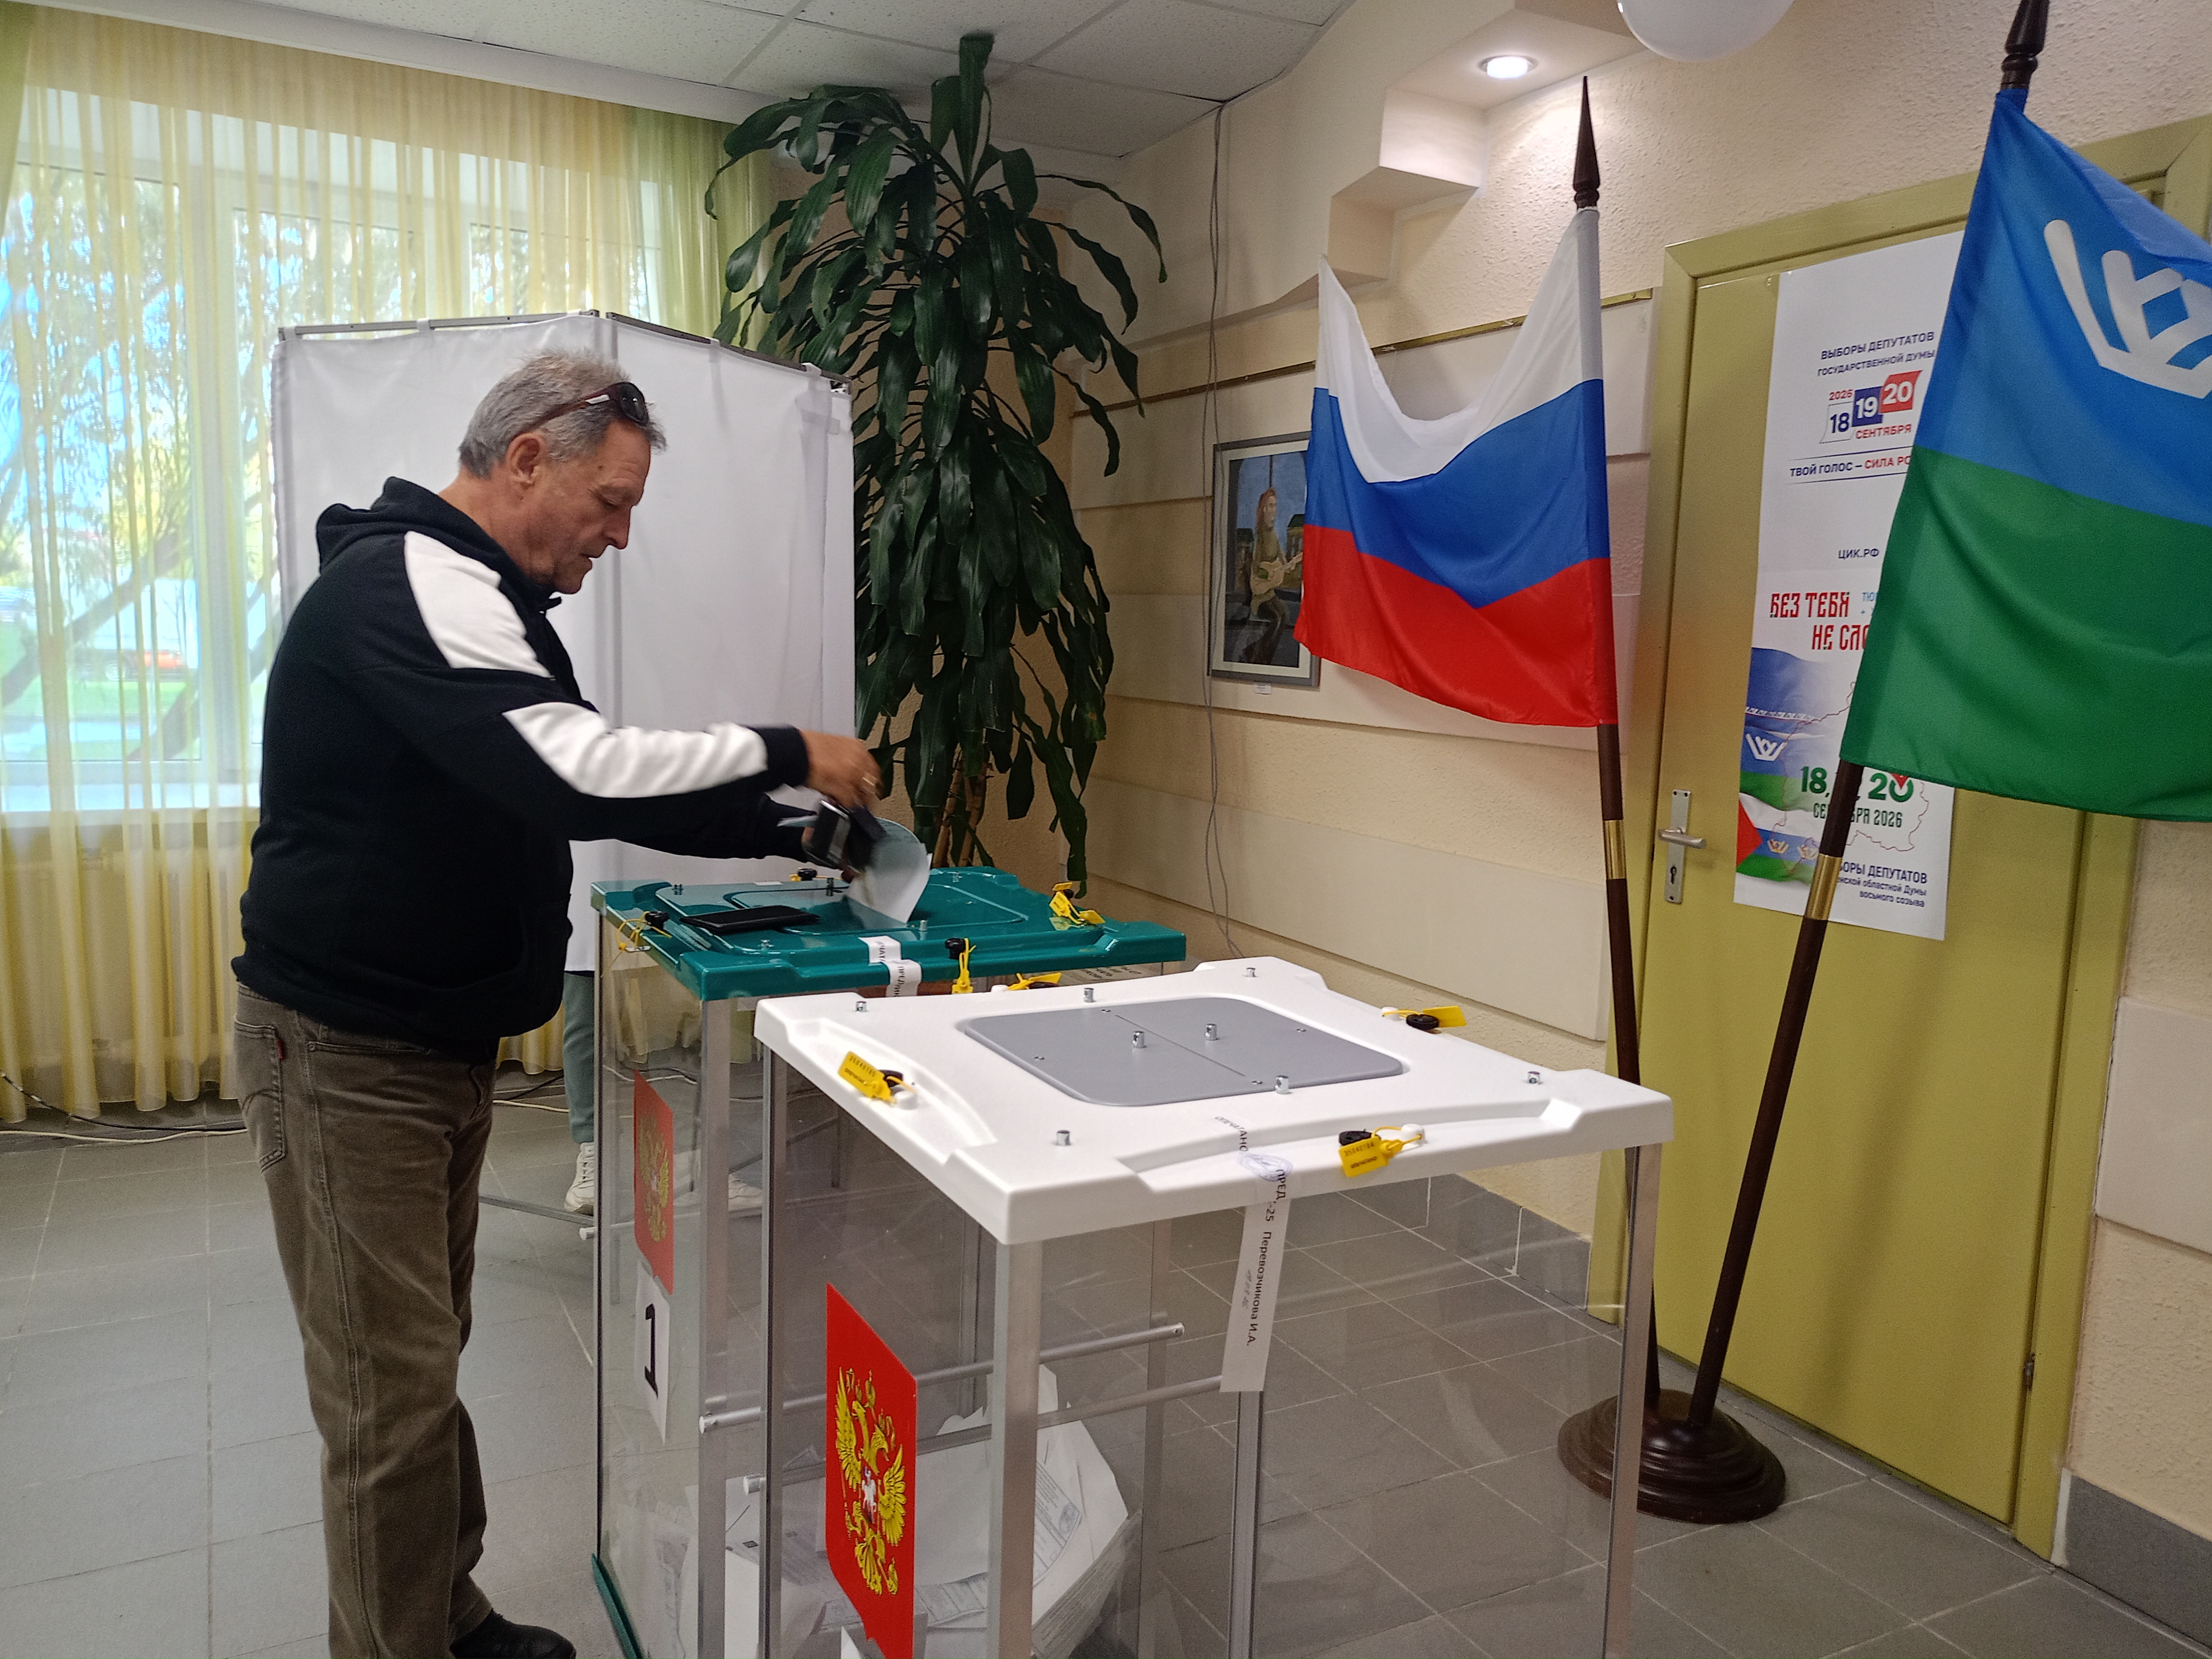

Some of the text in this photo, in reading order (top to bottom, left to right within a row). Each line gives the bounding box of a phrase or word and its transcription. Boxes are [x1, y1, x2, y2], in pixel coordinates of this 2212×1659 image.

[1821, 332, 1935, 360] ВЫБОРЫ ДЕПУТАТОВ
[1817, 350, 1936, 376] ГОСУДАРСТВЕННОЙ ДУМЫ
[1829, 389, 1854, 401] 2026
[1830, 381, 1913, 434] 18 19 20
[1856, 424, 1912, 439] СЕНТЯБРЯ
[1790, 464, 1817, 477] ТВОЙ
[1819, 462, 1854, 474] ГОЛОС
[1865, 457, 1895, 469] СИЛА
[1838, 548, 1880, 560] ЦИК.РФ
[1770, 592, 1850, 618] БЕЗ ТЕБЯ
[1812, 625, 1834, 650] НЕ
[1868, 773, 1914, 803] 20
[1873, 809, 1902, 828] 2026
[1868, 865, 1927, 884] ДЕПУТАТОВ
[1859, 891, 1925, 907] восьмого созыва
[1863, 880, 1902, 892] областной
[1903, 885, 1927, 896] Думы
[1251, 1231, 1272, 1319] Перевозчикова
[644, 1303, 659, 1400] 1
